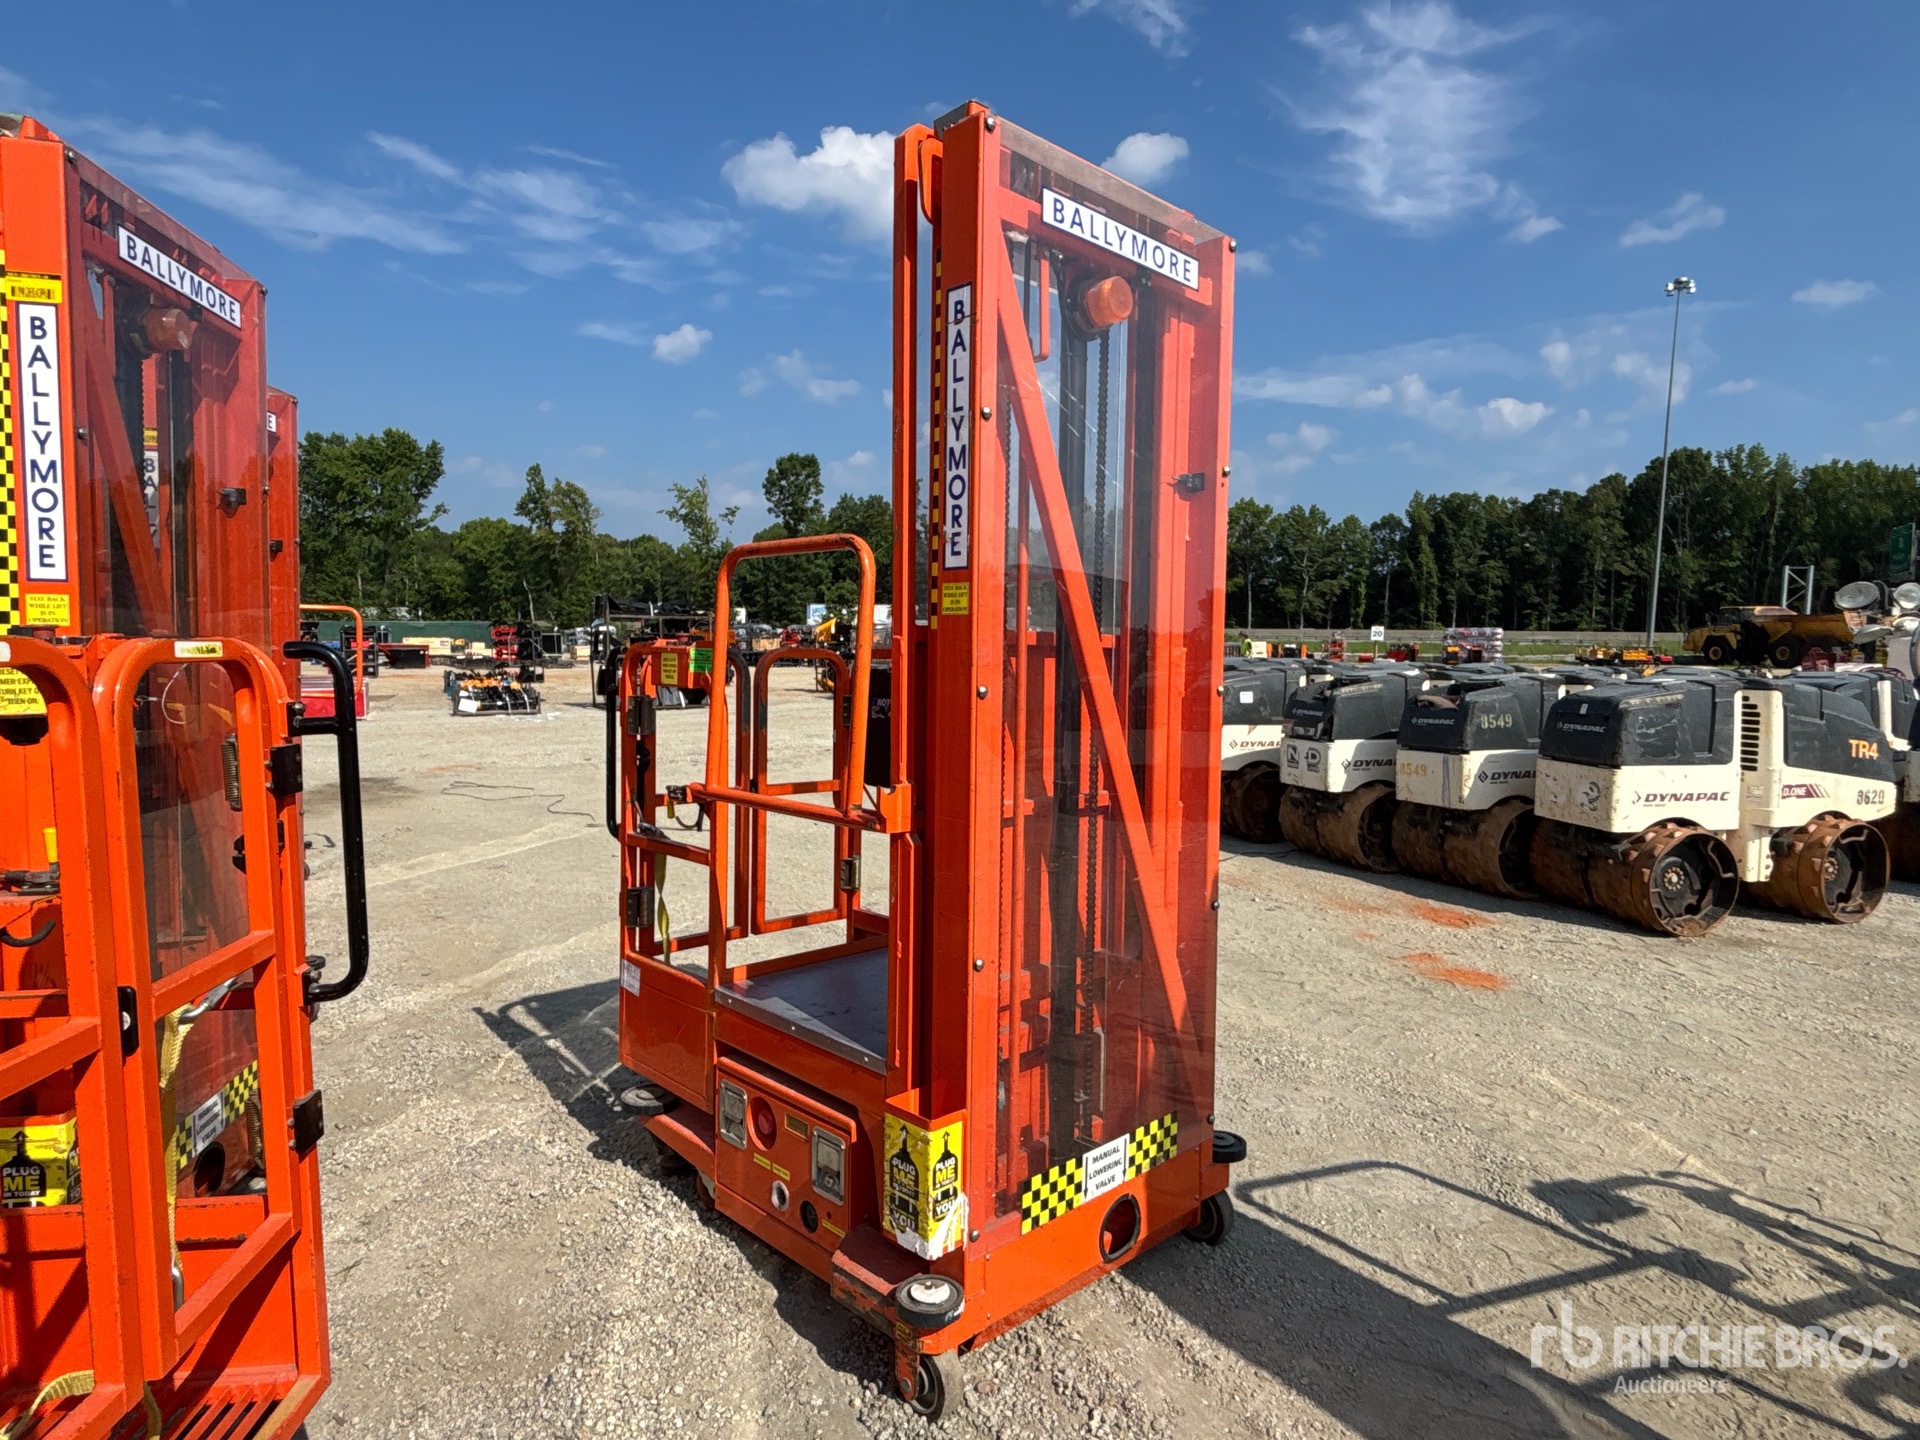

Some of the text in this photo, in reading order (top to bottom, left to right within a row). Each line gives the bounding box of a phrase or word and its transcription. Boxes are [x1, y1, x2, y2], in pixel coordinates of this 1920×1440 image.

[1053, 197, 1191, 283] BALLYMORE
[126, 234, 236, 322] BALLYMORE
[948, 299, 967, 557] BALLYMORE
[27, 316, 59, 568] BALLYMORE
[1562, 723, 1607, 733] DYNAPAC
[1849, 739, 1879, 759] TR4
[1643, 791, 1731, 803] DYNAPAC
[935, 1156, 956, 1171] PLUG
[1092, 1145, 1120, 1164] MANUAL
[2, 1166, 40, 1177] PLUG
[891, 1157, 916, 1176] PLUG
[936, 1165, 956, 1184] ME
[1089, 1158, 1123, 1180] LOWERING
[3, 1175, 40, 1192] ME
[1095, 1174, 1116, 1191] VALVE
[14, 1190, 40, 1198] TODAY
[935, 1200, 956, 1216] YOU
